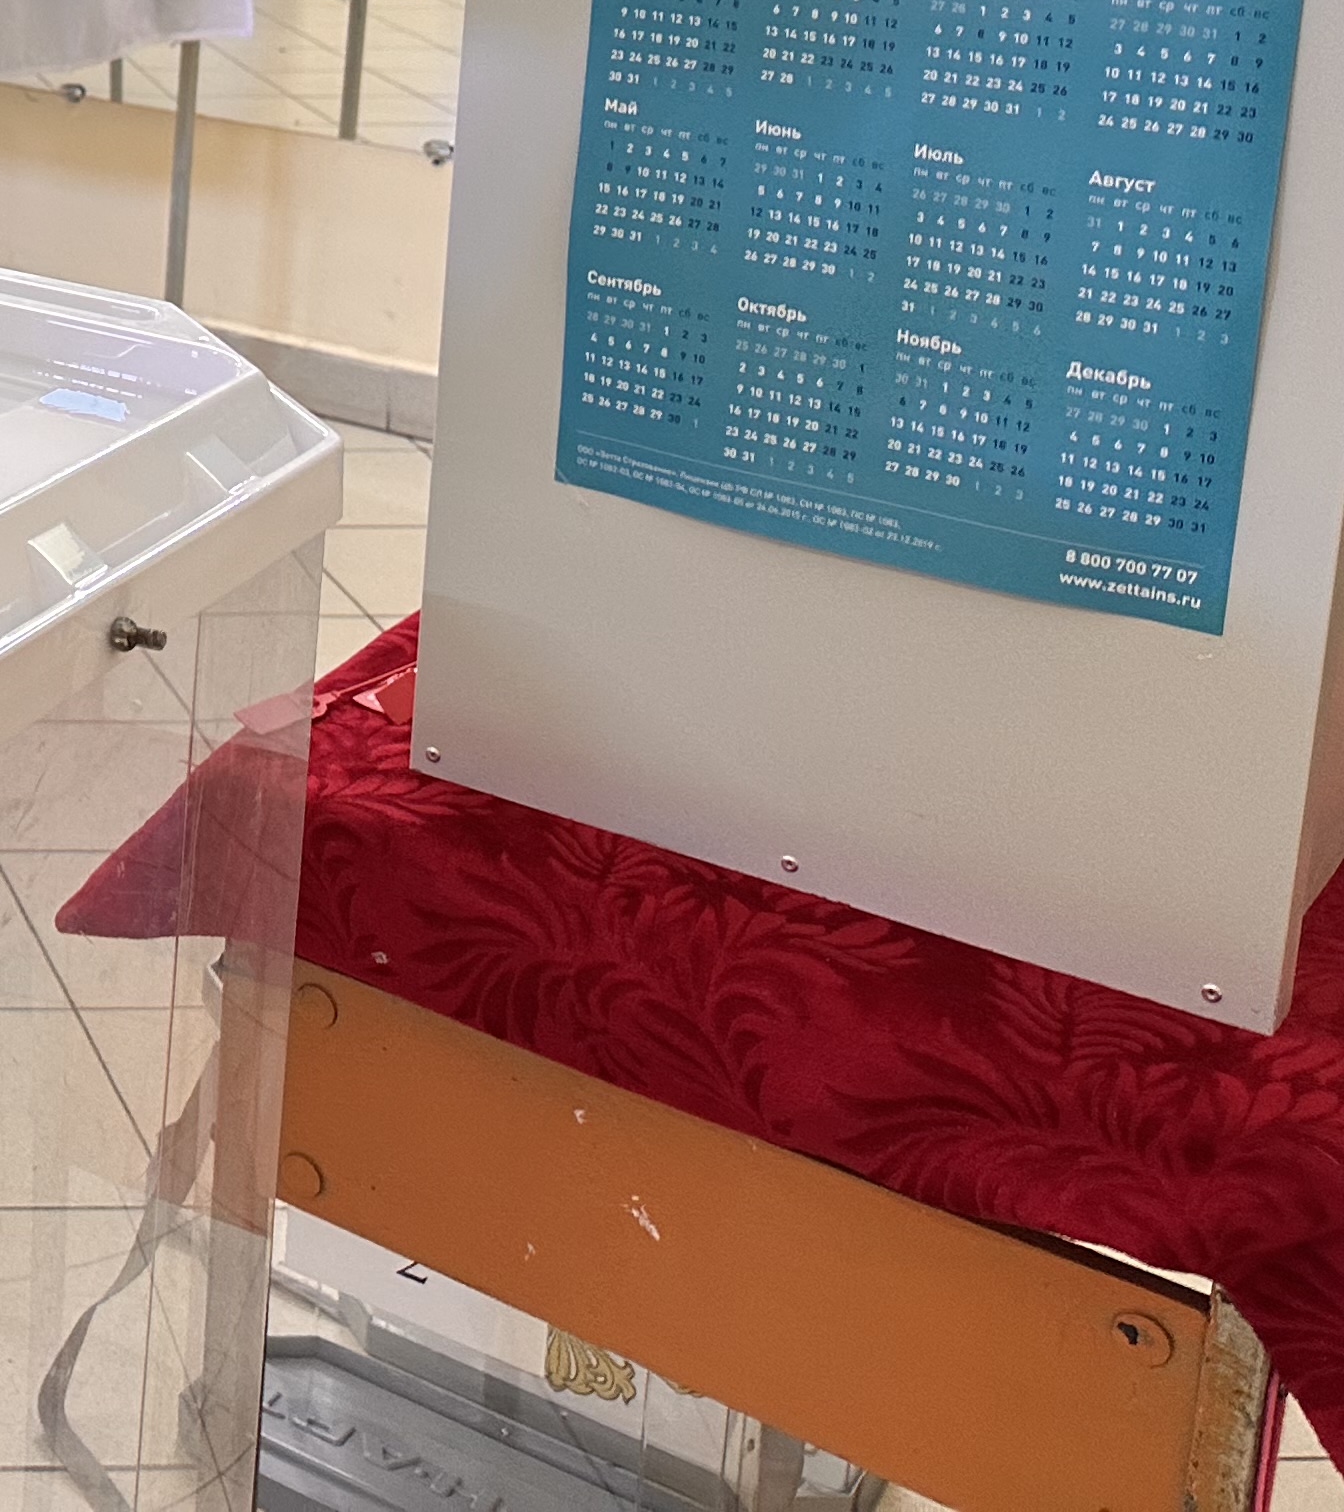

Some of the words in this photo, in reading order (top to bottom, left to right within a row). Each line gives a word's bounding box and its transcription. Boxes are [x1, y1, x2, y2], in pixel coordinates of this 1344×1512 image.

[1158, 0, 1175, 14] ср
[1183, 3, 1199, 13] чт
[1205, 5, 1223, 16] пт
[613, 27, 626, 39] 16
[631, 29, 645, 41] 17
[650, 32, 663, 44] 18
[668, 34, 681, 46] 19
[685, 36, 699, 49] 20
[703, 39, 717, 51] 21
[722, 42, 736, 54] 22
[765, 25, 779, 37] 13
[784, 27, 798, 39] 14
[803, 30, 817, 42] 15
[822, 32, 836, 45] 16
[842, 35, 856, 47] 17
[862, 38, 876, 50] 18
[882, 40, 896, 52] 19
[926, 45, 941, 59] 13
[946, 48, 961, 61] 14
[968, 50, 983, 64] 15
[989, 53, 1004, 67] 16
[1011, 55, 1027, 68] 17
[1034, 58, 1048, 71] 18
[1056, 60, 1071, 73] 19
[1105, 66, 1120, 79] 10
[1127, 68, 1142, 81] 11
[1150, 71, 1167, 84] 12
[1174, 73, 1189, 87] 13
[1197, 76, 1213, 89] 14
[1220, 79, 1236, 92] 15
[1245, 82, 1260, 95] 16
[604, 97, 638, 115] Май
[755, 120, 801, 140] Июнь
[913, 144, 964, 166] Июль
[598, 181, 611, 194] 15
[616, 184, 629, 197] 16
[635, 187, 648, 199] 17
[653, 190, 666, 203] 18
[671, 193, 685, 205] 19
[689, 196, 704, 208] 20
[708, 199, 721, 211] 21
[1089, 170, 1156, 194] Август
[750, 206, 763, 218] 12
[768, 209, 782, 221] 13
[788, 211, 801, 225] 14
[807, 215, 821, 228] 15
[826, 219, 840, 232] 16
[846, 222, 860, 234] 17
[866, 226, 879, 238] 18
[587, 270, 662, 298] Сентябрь
[906, 255, 921, 268] 17
[926, 259, 941, 272] 18
[947, 262, 962, 275] 19
[966, 266, 983, 279] 20
[987, 269, 1002, 283] 21
[1008, 274, 1025, 286] 22
[1030, 277, 1046, 290] 23
[1082, 263, 1097, 277] 14
[1104, 267, 1120, 280] 15
[1127, 270, 1142, 284] 16
[1149, 273, 1166, 287] 17
[1173, 277, 1188, 291] 18
[1196, 280, 1211, 294] 19
[1217, 284, 1234, 297] 20
[737, 297, 807, 324] Октябрь
[897, 328, 962, 355] Ноябрь
[584, 351, 596, 363] 11
[601, 355, 614, 368] 12
[618, 359, 631, 371] 13
[635, 363, 648, 375] 14
[653, 366, 666, 379] 15
[672, 371, 684, 383] 16
[691, 374, 704, 386] 17
[1067, 360, 1152, 391] Декабрь
[1066, 385, 1083, 396] пн
[1091, 389, 1106, 400] вт
[1112, 393, 1128, 406] ср
[1136, 398, 1151, 408] чт
[1158, 401, 1174, 412] пт
[728, 403, 742, 416] 16
[747, 407, 762, 419] 17
[766, 411, 780, 424] 18
[786, 415, 800, 428] 19
[804, 419, 820, 432] 20
[824, 423, 838, 436] 21
[844, 427, 859, 440] 22
[890, 416, 905, 429] 13
[910, 420, 924, 434] 14
[931, 425, 945, 438] 15
[951, 429, 965, 442] 16
[972, 433, 987, 446] 17
[993, 438, 1007, 451] 18
[1014, 442, 1028, 455] 19
[1060, 452, 1075, 465] 11
[1083, 456, 1098, 470] 12
[1105, 460, 1121, 474] 13
[1128, 464, 1143, 478] 14
[1151, 468, 1166, 482] 15
[1174, 472, 1189, 485] 16
[1197, 476, 1213, 489] 17
[1065, 549, 1076, 563] 8
[1081, 552, 1112, 569] 800
[1117, 557, 1147, 575] 700
[1152, 563, 1172, 580] 77
[1176, 568, 1198, 585] 07
[1059, 572, 1202, 609] www.zettains.ru
